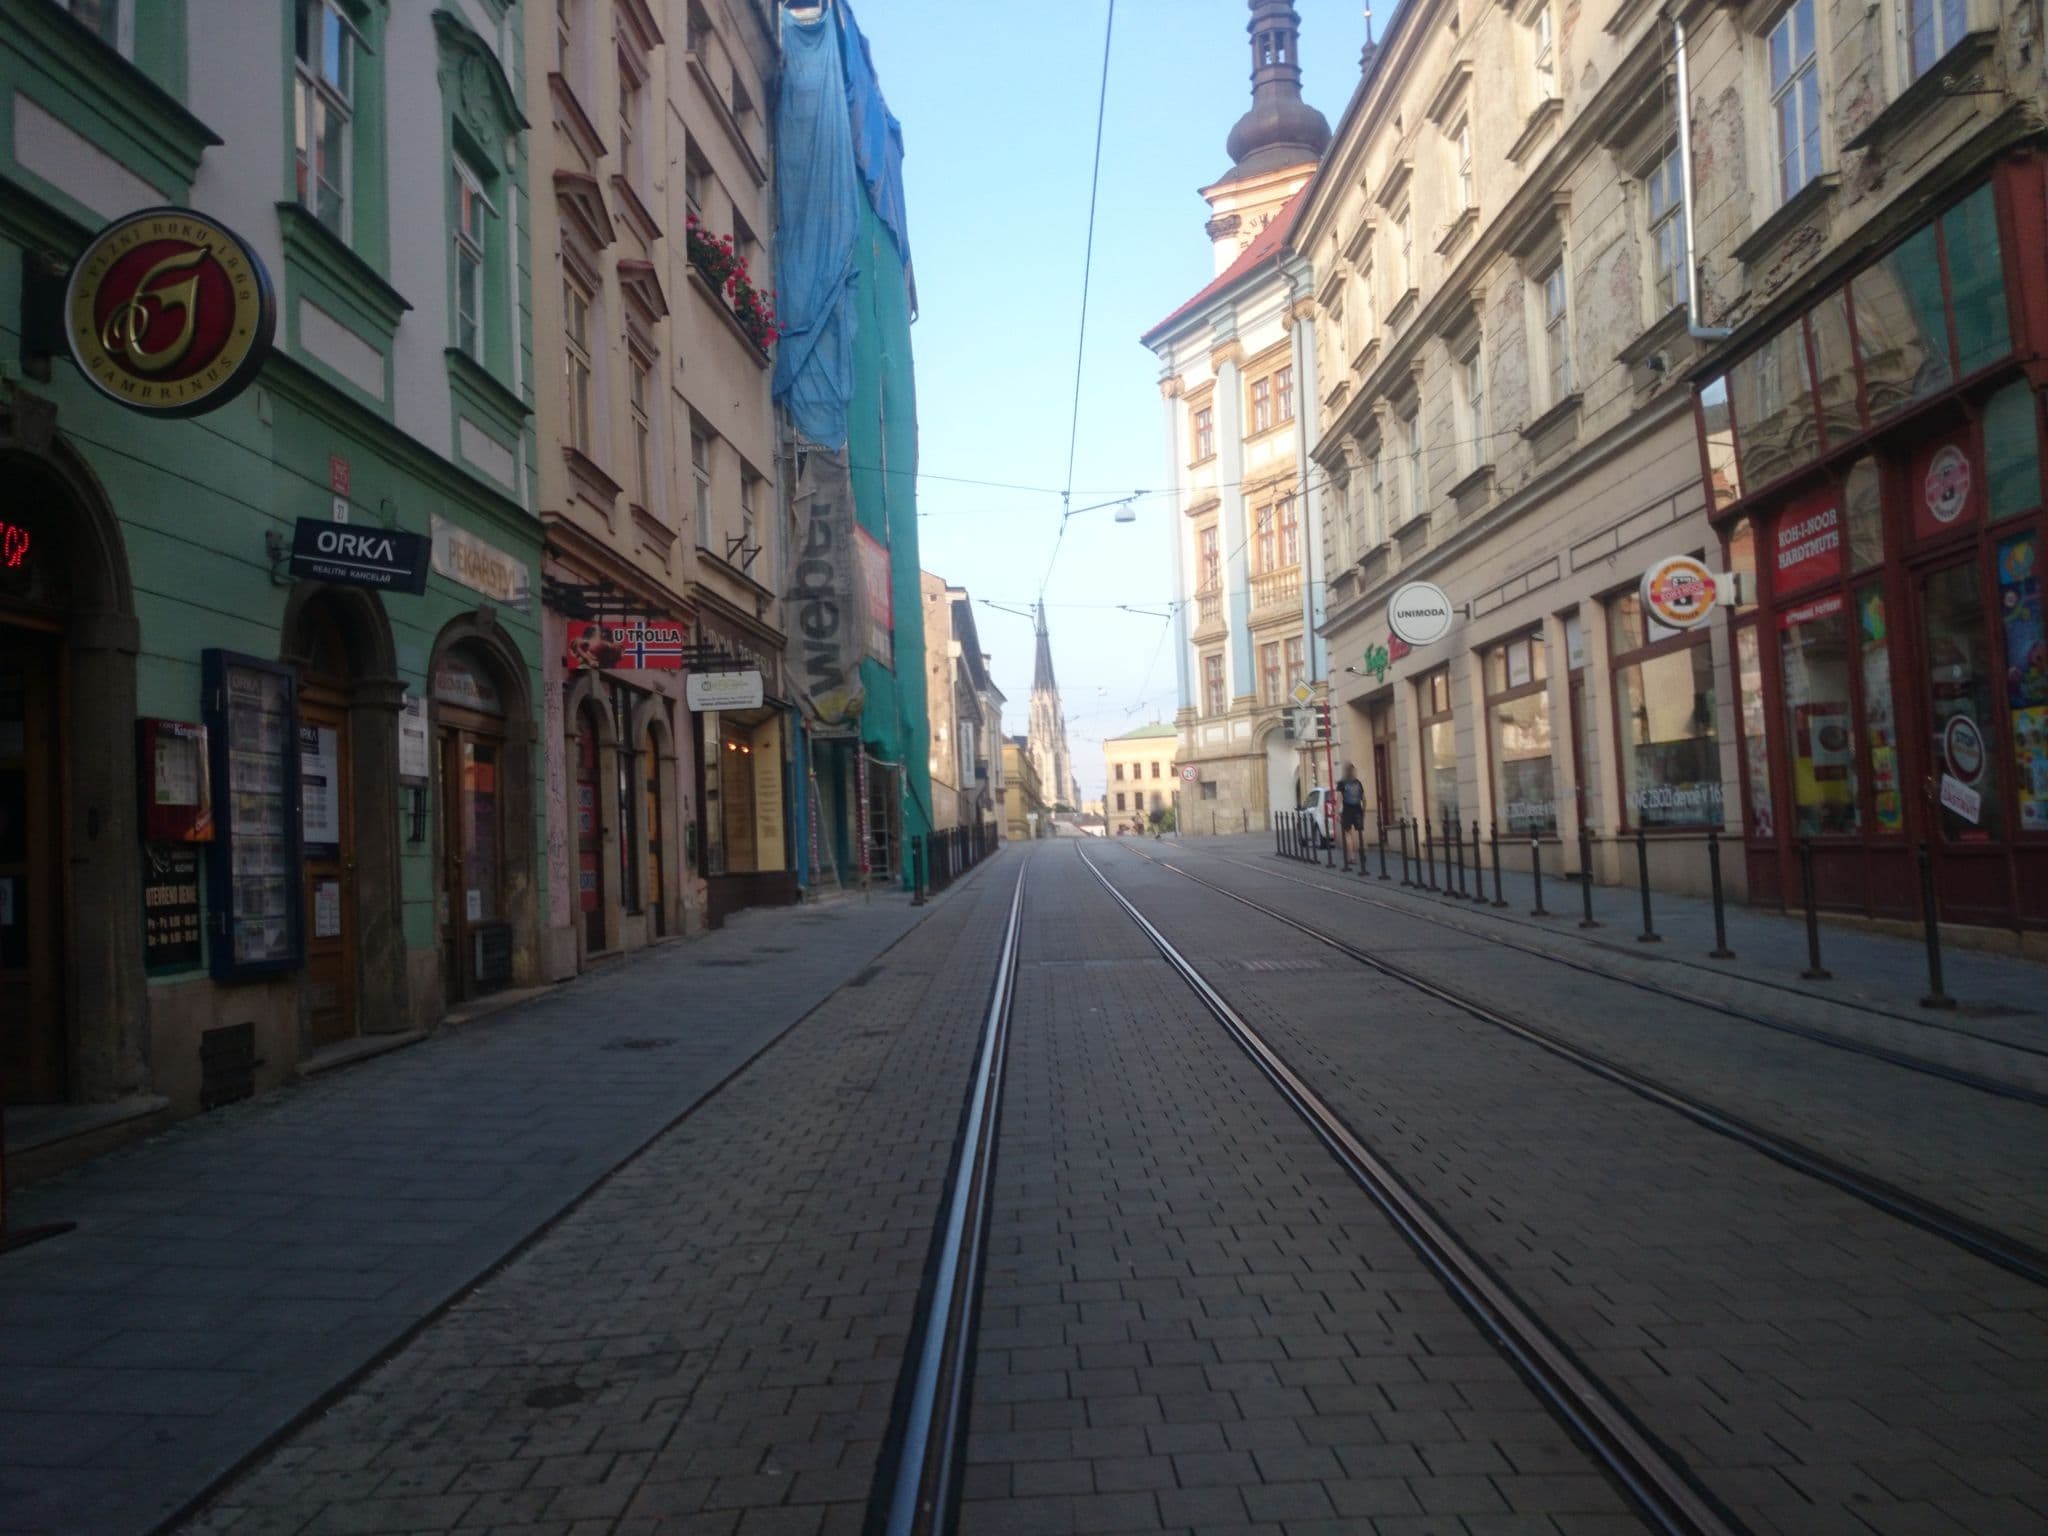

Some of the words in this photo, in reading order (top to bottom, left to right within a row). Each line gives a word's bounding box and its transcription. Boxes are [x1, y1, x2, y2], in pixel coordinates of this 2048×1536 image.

[91, 354, 235, 400] GAMBRINUS
[317, 530, 394, 562] ORKA
[1396, 608, 1446, 619] UNIMODA
[612, 628, 625, 643] U
[627, 629, 681, 644] TROLLA
